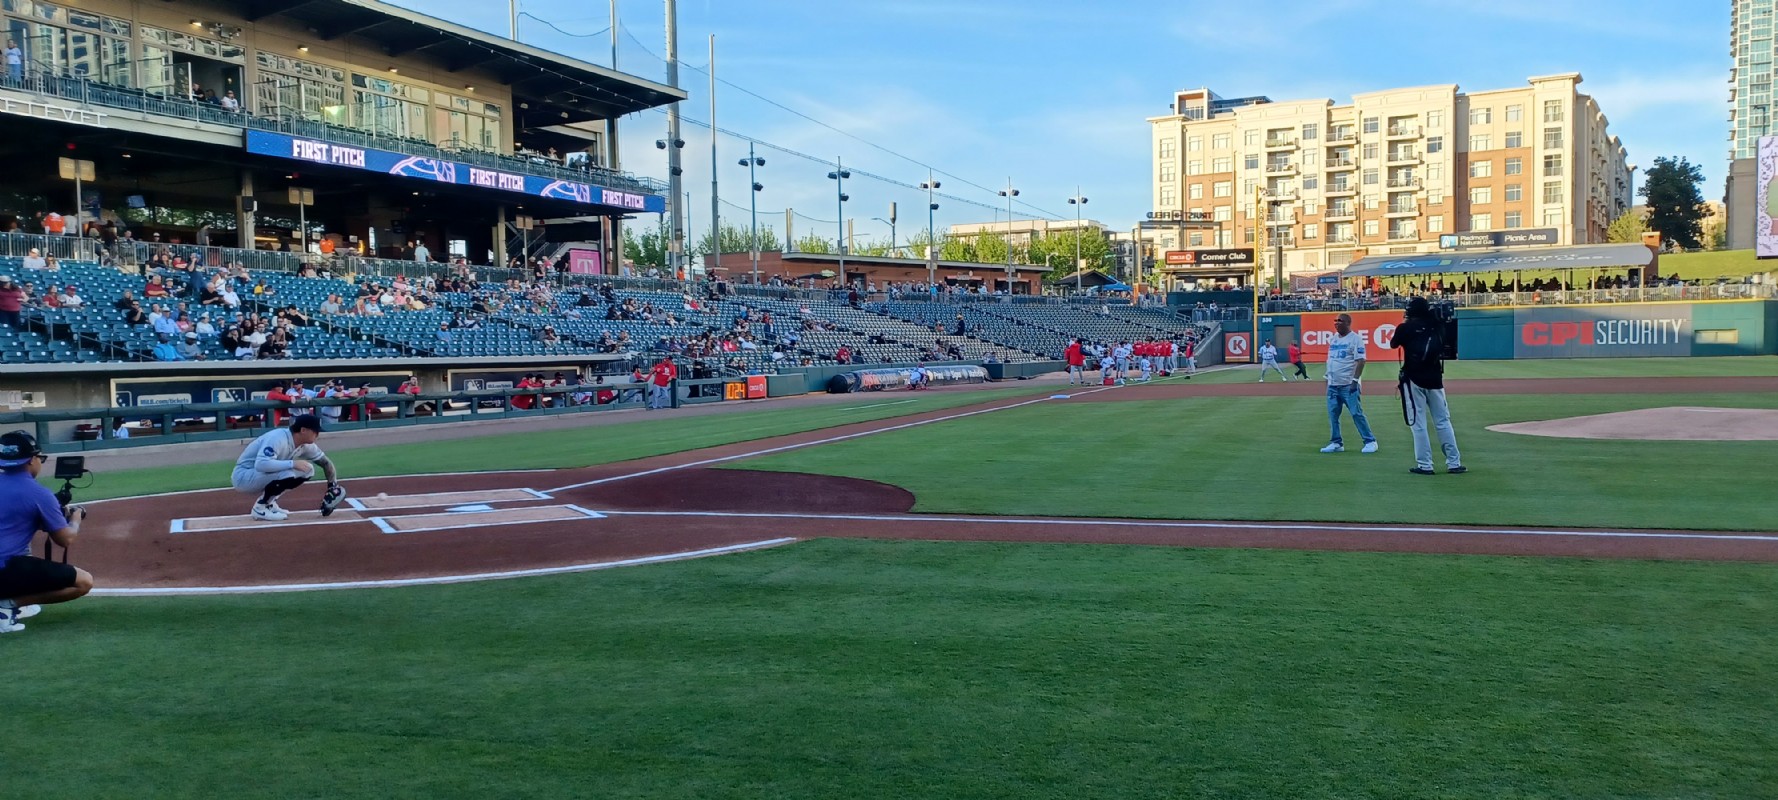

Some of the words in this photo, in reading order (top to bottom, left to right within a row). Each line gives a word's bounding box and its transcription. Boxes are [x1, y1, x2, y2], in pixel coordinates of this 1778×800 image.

[293, 140, 328, 160] FIRST
[331, 146, 366, 167] PITCH
[469, 168, 496, 186] FIRST
[498, 173, 524, 190] PITCH
[602, 190, 623, 205] FIRST
[624, 195, 644, 209] PITCH
[1504, 234, 1527, 243] Picnic
[1528, 233, 1547, 241] Area
[1201, 253, 1227, 261] Corner
[1228, 252, 1246, 260] Club
[1303, 329, 1369, 346] CIRE
[1522, 321, 1595, 346] CPI
[1597, 318, 1682, 344] SECURITY
